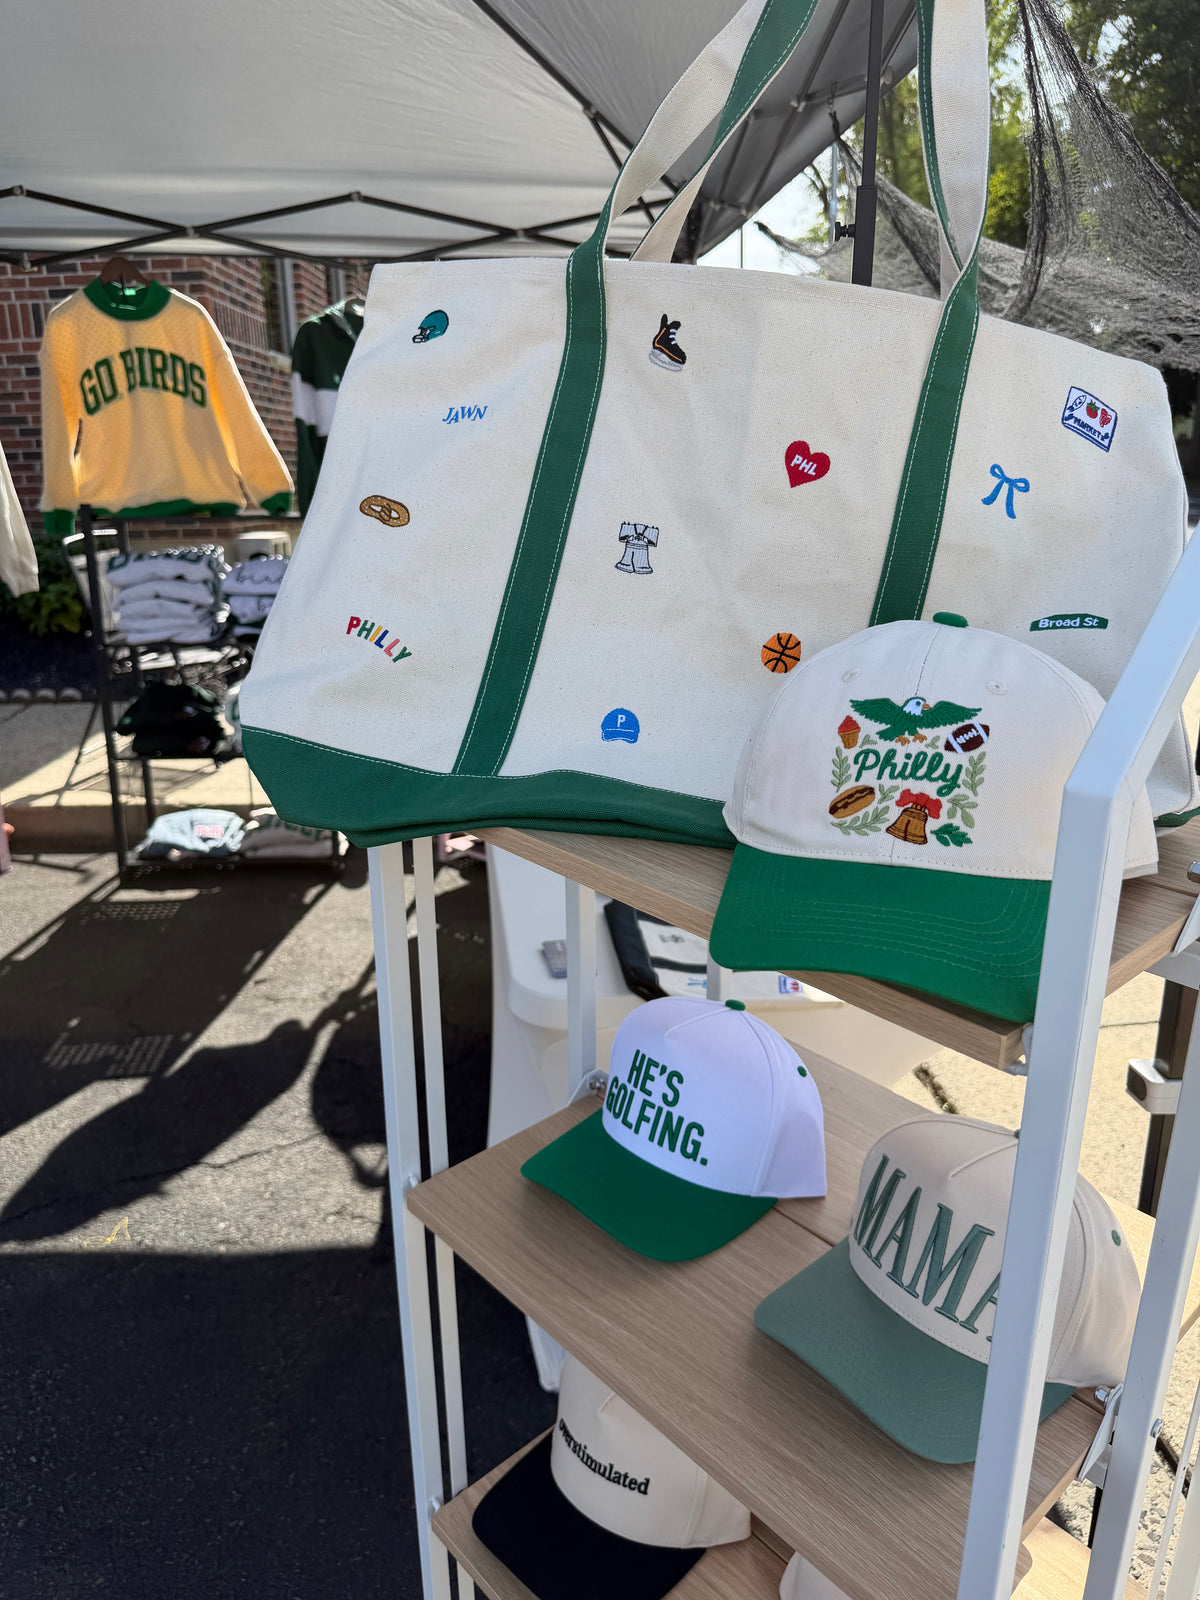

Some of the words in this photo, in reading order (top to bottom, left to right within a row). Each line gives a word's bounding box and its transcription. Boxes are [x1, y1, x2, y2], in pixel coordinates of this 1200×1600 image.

[80, 357, 119, 415] GO
[120, 347, 207, 408] BIRDS
[442, 405, 488, 424] JAWN
[1073, 416, 1102, 439] MARKET
[790, 454, 817, 476] PHL
[346, 616, 412, 663] PHILLY
[1038, 617, 1081, 628] Broad
[1082, 617, 1099, 627] St
[617, 714, 626, 728] P
[853, 749, 963, 797] Philly
[627, 1049, 684, 1107] HE'S
[605, 1075, 708, 1166] GOLFING.
[559, 1418, 650, 1495] overstimulated
